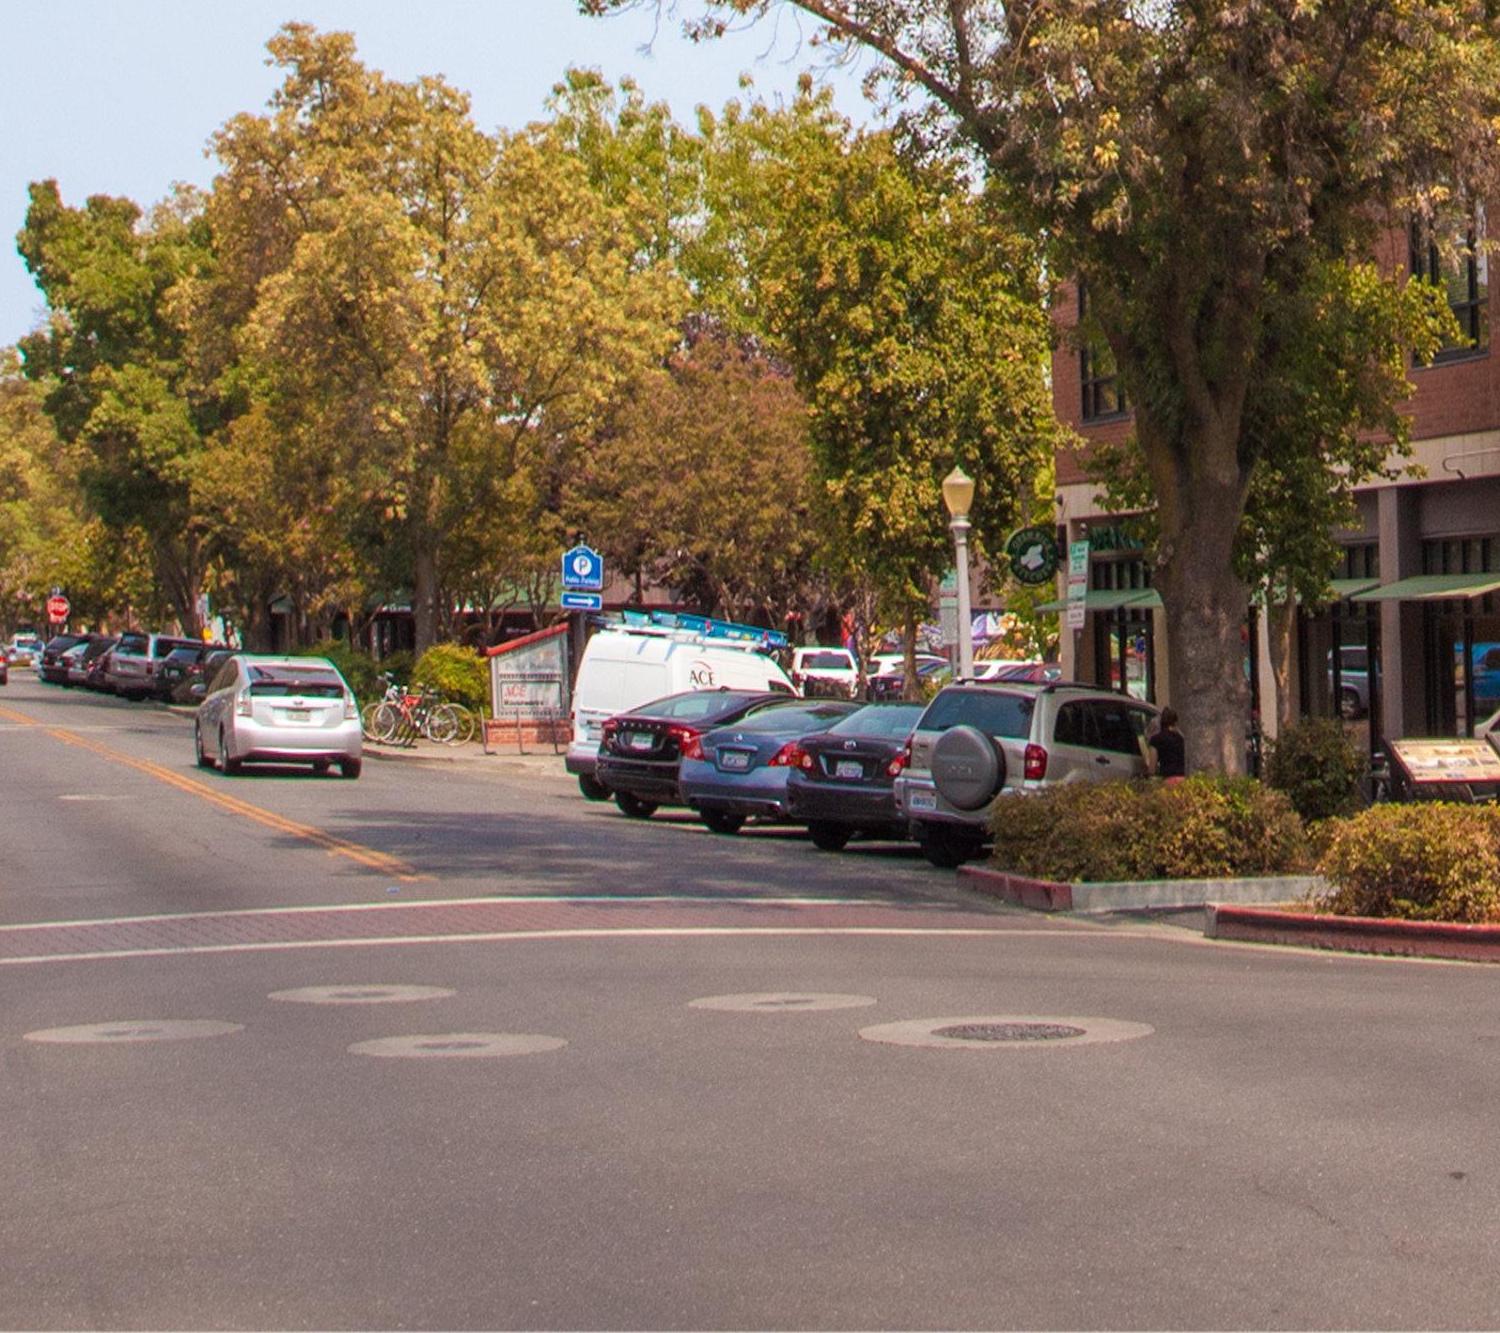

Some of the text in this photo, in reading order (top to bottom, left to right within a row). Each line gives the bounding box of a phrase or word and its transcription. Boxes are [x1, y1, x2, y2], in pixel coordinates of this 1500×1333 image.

[579, 558, 588, 572] P
[48, 601, 69, 612] STOP
[689, 669, 716, 686] ACE
